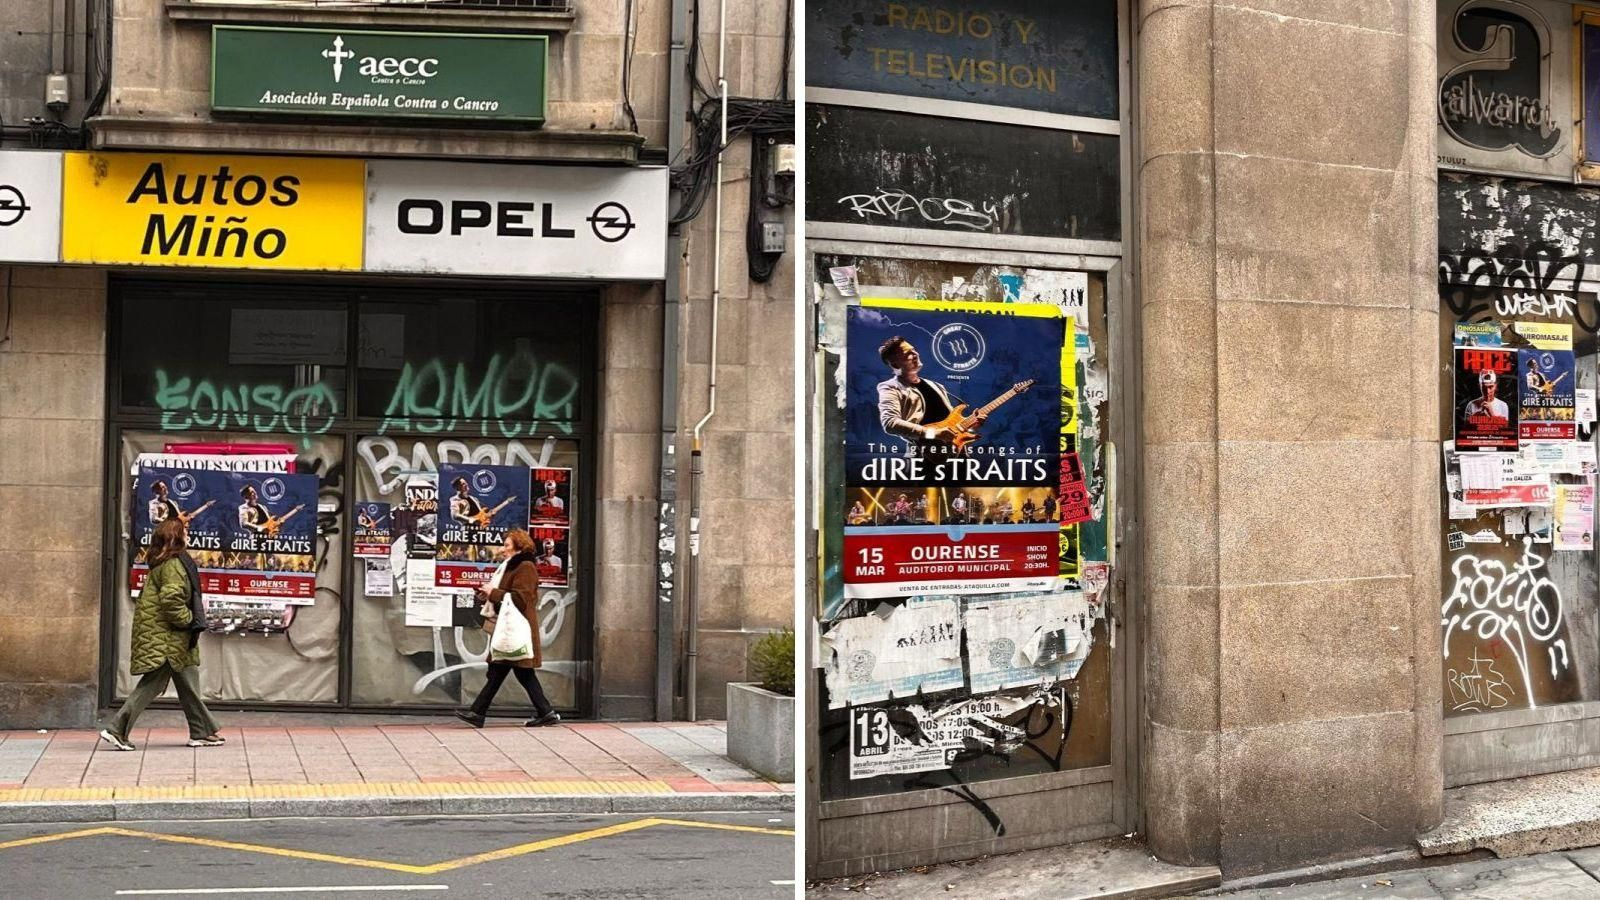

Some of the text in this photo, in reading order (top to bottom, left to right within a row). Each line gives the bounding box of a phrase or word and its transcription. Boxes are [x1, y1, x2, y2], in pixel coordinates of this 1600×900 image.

[888, 4, 1035, 44] RADIO Y
[359, 56, 439, 78] aecc
[866, 47, 1058, 93] TELEVISION
[371, 76, 394, 85] Contra
[402, 77, 426, 85] Cancro
[260, 90, 498, 111] Asociación Española Contra o Cancro
[127, 162, 301, 207] Autos
[397, 198, 576, 240] OPEL
[140, 213, 287, 259] Miño
[1457, 324, 1499, 332] DINOSAURIOS
[1522, 398, 1573, 407] dIRE sTRAITS
[868, 443, 1041, 457] The great songs of
[861, 457, 924, 482] dIRE
[935, 457, 1047, 482] sTRAITS
[1060, 491, 1084, 505] 29
[140, 534, 220, 548] dI RAITS
[442, 531, 504, 544] dIRE sTRA
[231, 538, 311, 553] dIRE sTRAITS
[911, 544, 1001, 561] OURENSE
[858, 547, 884, 564] 15
[1026, 553, 1048, 561] SHOW
[440, 571, 452, 579] 15
[855, 566, 885, 576] MAR
[899, 561, 1011, 575] AUDITORIO MUNICIPAL
[228, 579, 240, 587] 15
[250, 580, 289, 588] OURENSE
[966, 702, 1003, 713] 19:00 h.
[857, 711, 889, 747] 13
[948, 728, 974, 740] 12:00
[860, 747, 884, 756] ABRIL
